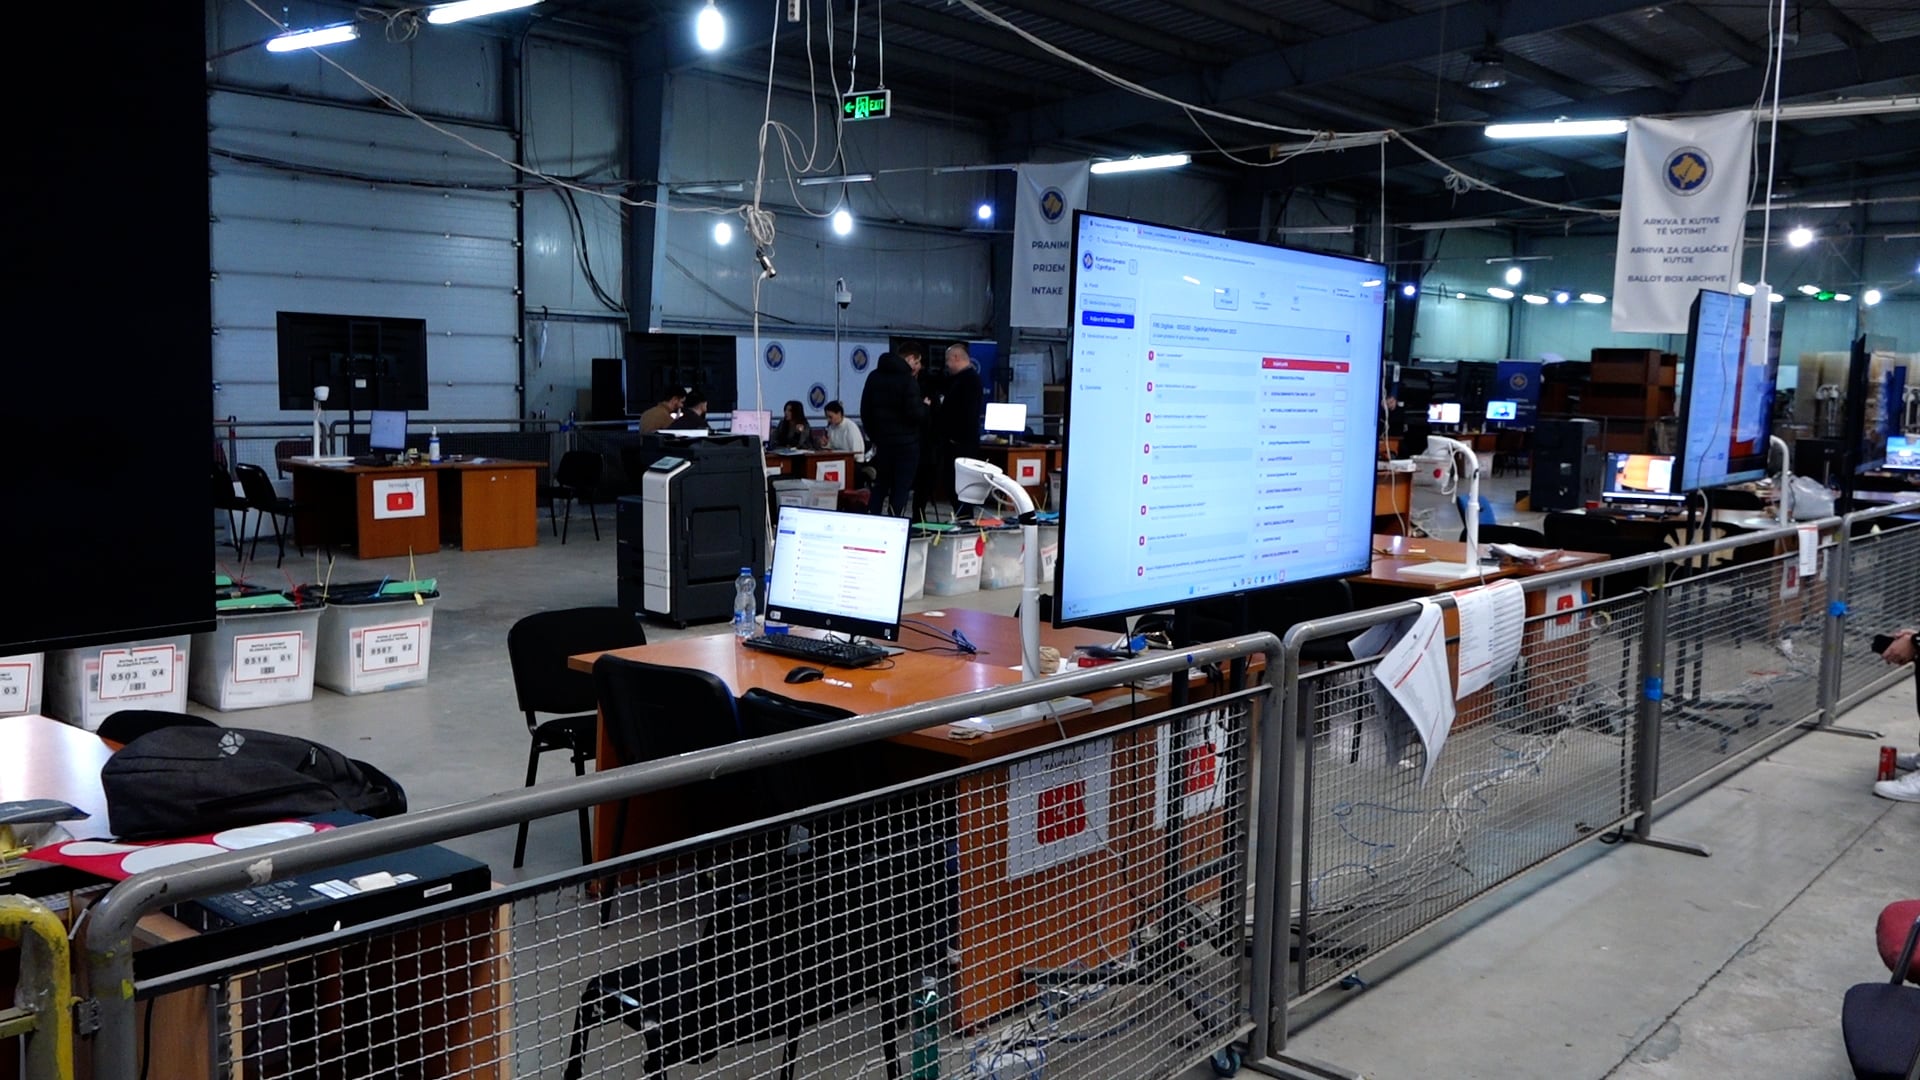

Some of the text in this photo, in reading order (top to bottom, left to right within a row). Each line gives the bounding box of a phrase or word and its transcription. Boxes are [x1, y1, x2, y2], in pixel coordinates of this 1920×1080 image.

[870, 98, 884, 111] EXIT
[1643, 216, 1720, 226] ARKIVA E KUTIVE
[1670, 227, 1707, 235] VOTIMIT
[1031, 240, 1069, 249] PRANIMI
[1630, 244, 1729, 254] ARHIVA ZA GLASAČKE
[1663, 256, 1694, 264] KUTIJE
[1032, 263, 1066, 273] PRIJEM
[1627, 275, 1662, 283] BALLOT
[1031, 286, 1063, 295] INTAKE
[110, 668, 164, 681] 0503 04
[3, 686, 18, 695] 03
